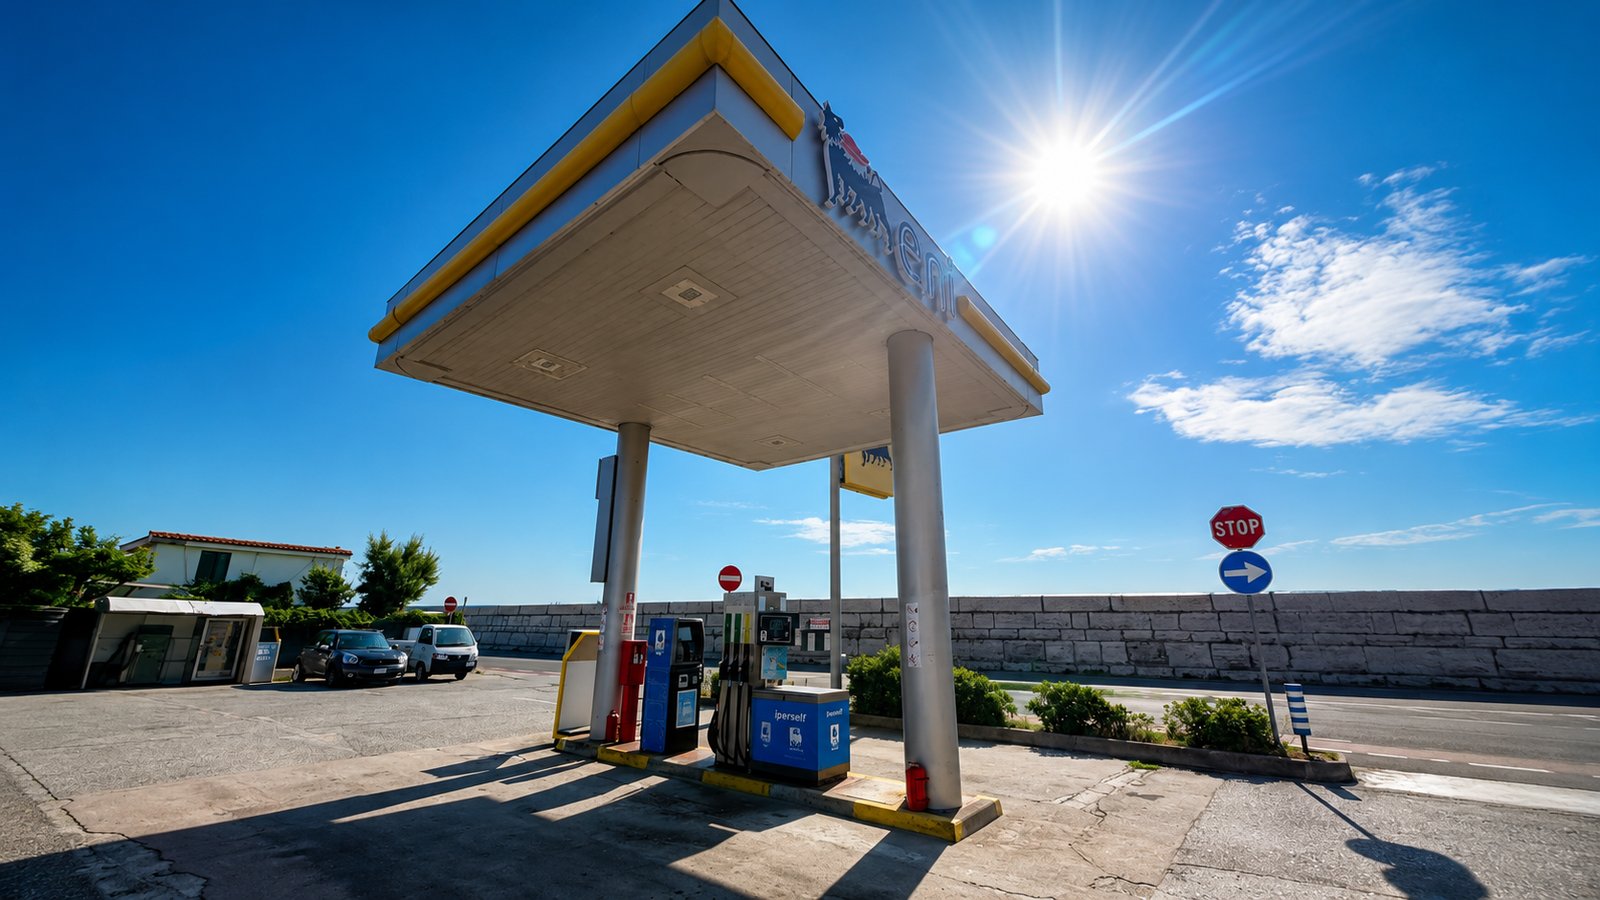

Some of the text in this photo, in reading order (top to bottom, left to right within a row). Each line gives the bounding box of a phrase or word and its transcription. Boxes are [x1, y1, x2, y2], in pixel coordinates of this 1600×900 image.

[896, 221, 957, 320] eni
[1214, 518, 1259, 537] STOP
[775, 709, 807, 723] iperself
